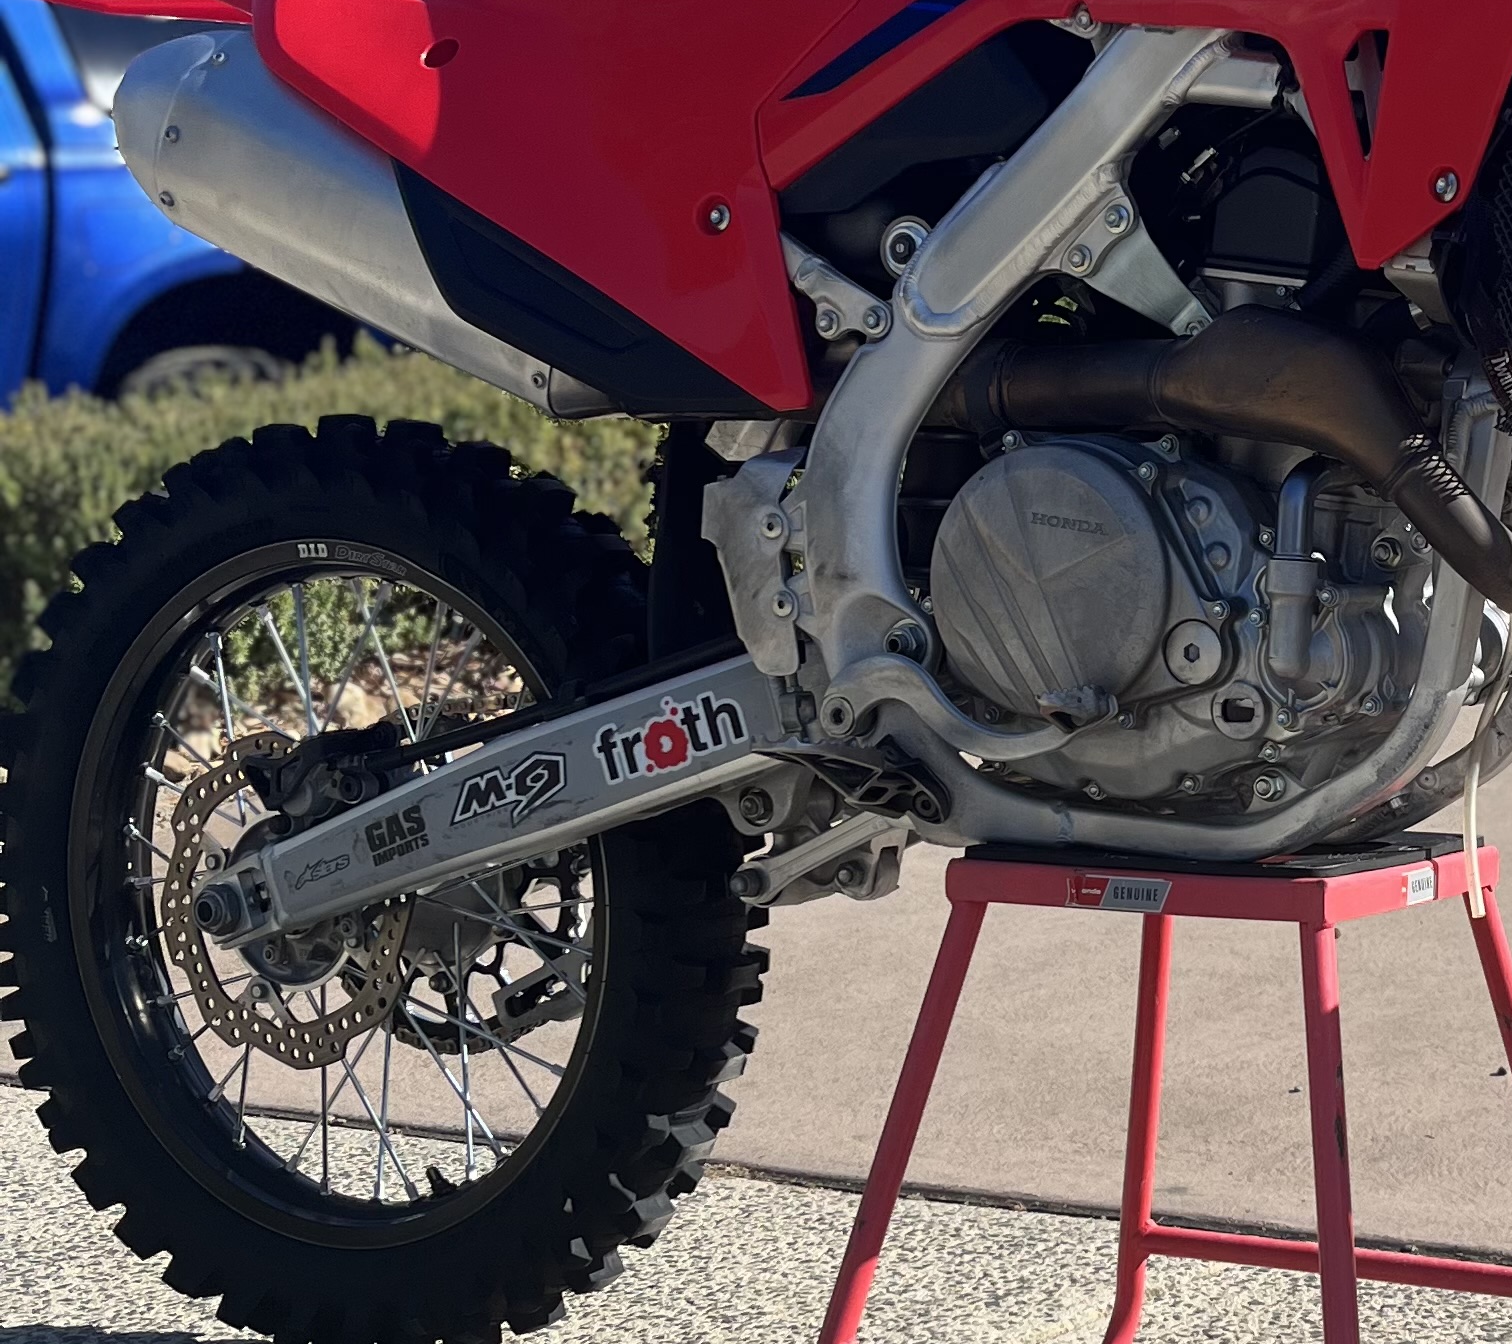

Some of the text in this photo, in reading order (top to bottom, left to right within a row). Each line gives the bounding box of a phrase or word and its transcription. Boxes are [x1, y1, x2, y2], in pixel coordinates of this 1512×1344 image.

[1030, 511, 1109, 536] HONDA
[597, 692, 746, 782] froth
[364, 805, 426, 853] GAS
[372, 833, 430, 867] IMPORTS
[1113, 886, 1159, 902] GENUINE
[1411, 875, 1433, 894] GENUINE
